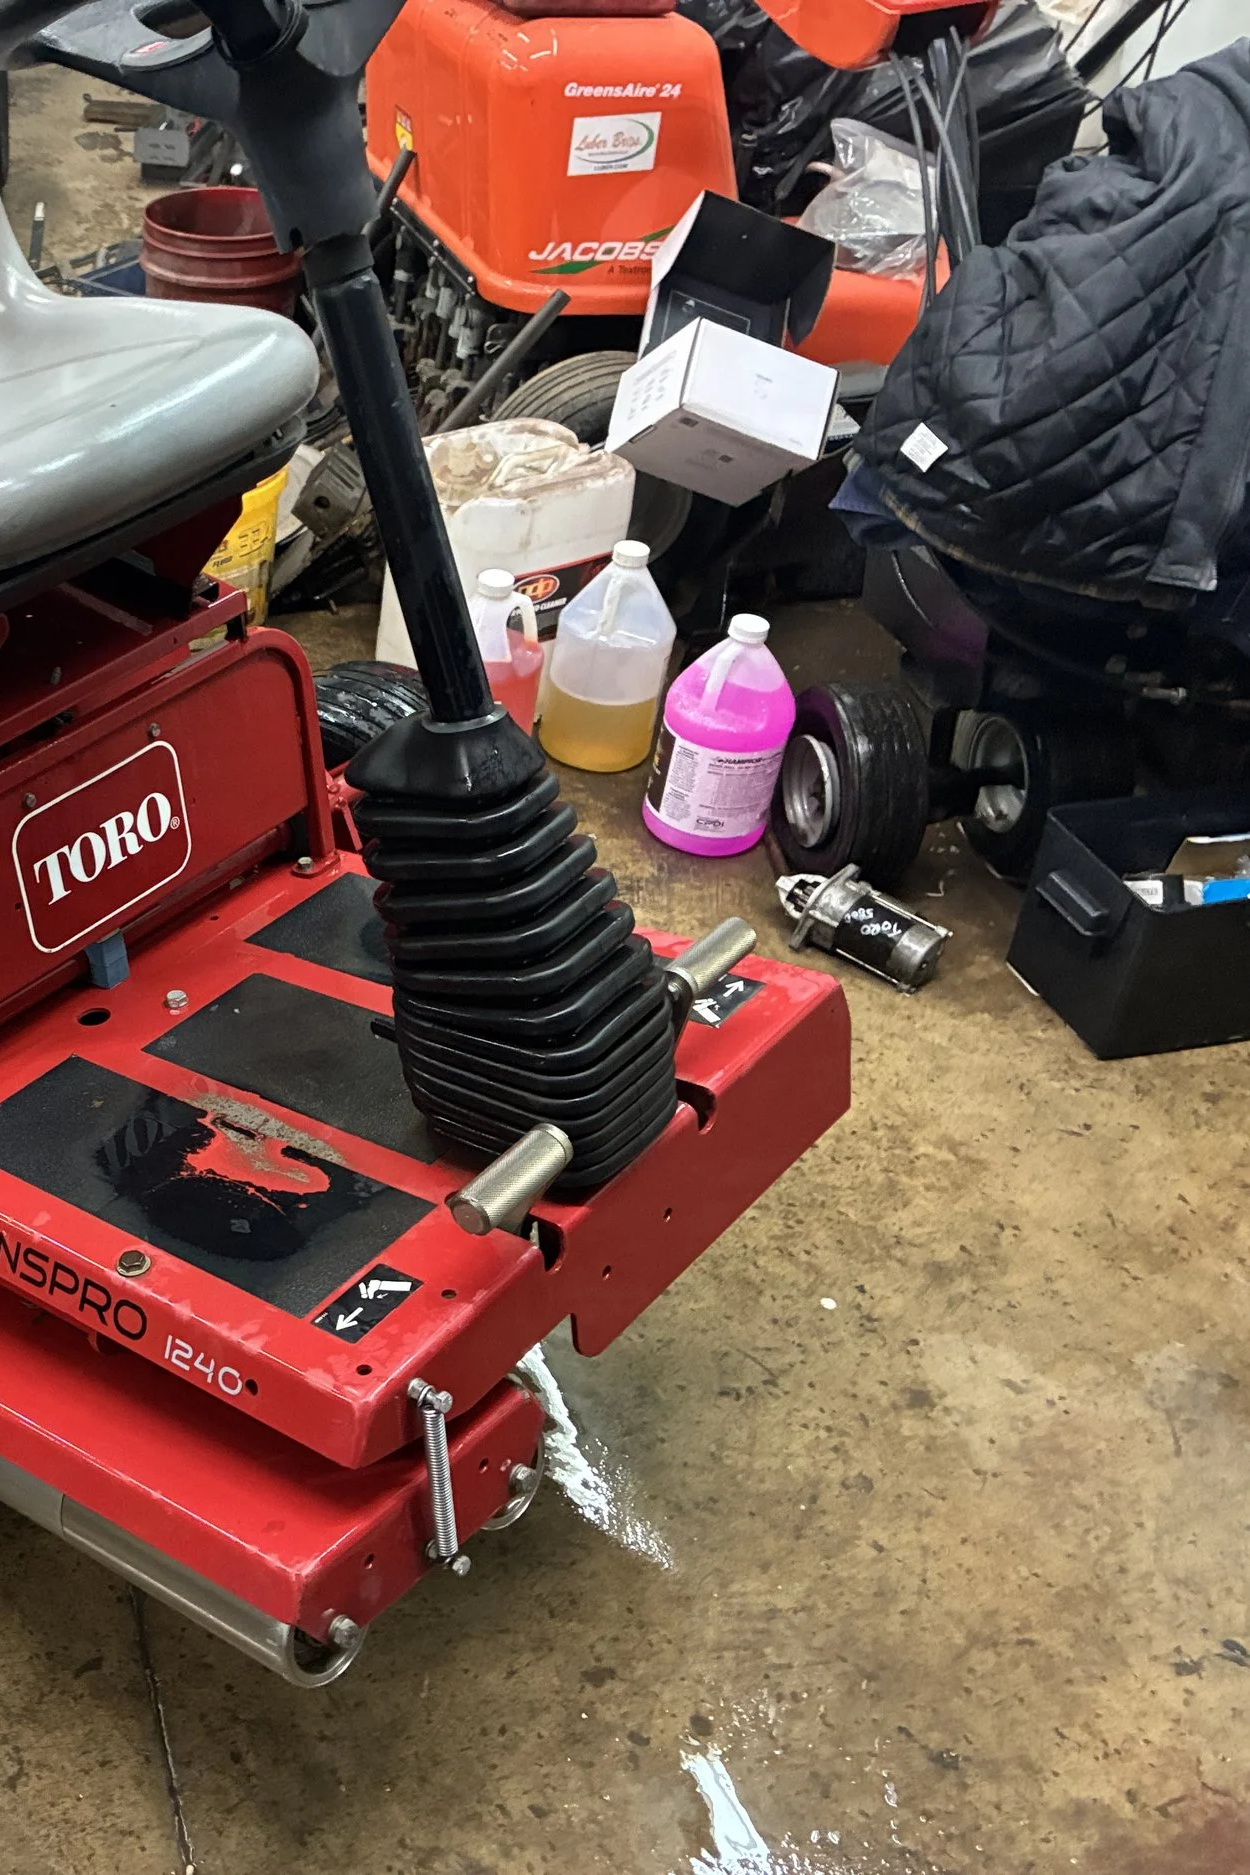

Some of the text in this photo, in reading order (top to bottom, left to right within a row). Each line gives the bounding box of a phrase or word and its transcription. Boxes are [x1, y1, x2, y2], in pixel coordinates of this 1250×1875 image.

[659, 83, 683, 98] 24
[860, 920, 903, 938] TORO
[164, 1334, 244, 1397] 1240
